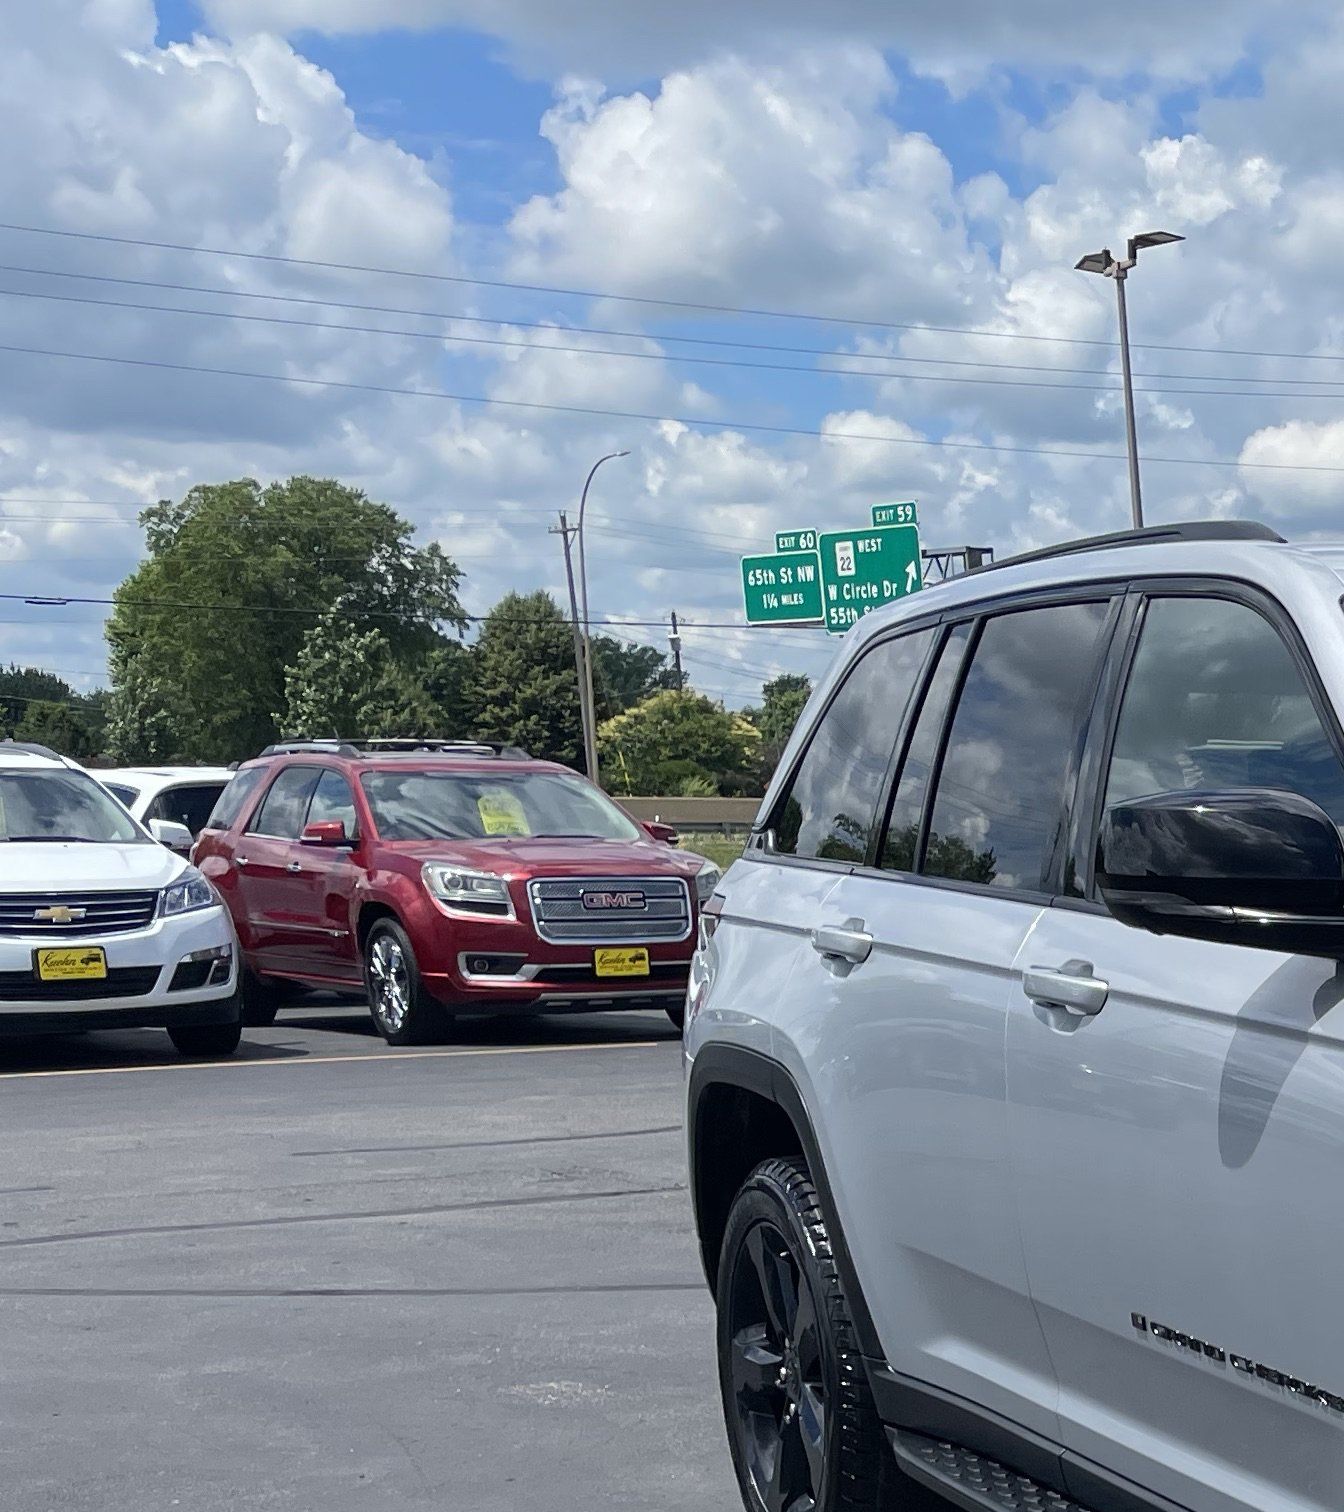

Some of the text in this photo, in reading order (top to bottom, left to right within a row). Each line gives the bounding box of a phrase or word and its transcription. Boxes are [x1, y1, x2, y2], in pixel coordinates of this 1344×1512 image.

[875, 505, 913, 522] EXIT 59
[779, 532, 814, 549] EXIT 60
[857, 538, 882, 553] WEST
[840, 557, 852, 571] 22
[748, 565, 814, 586] 65th St NW
[828, 580, 898, 600] W Circle Dr
[781, 593, 804, 606] MILES
[830, 607, 858, 624] 55th
[583, 892, 645, 908] GMC
